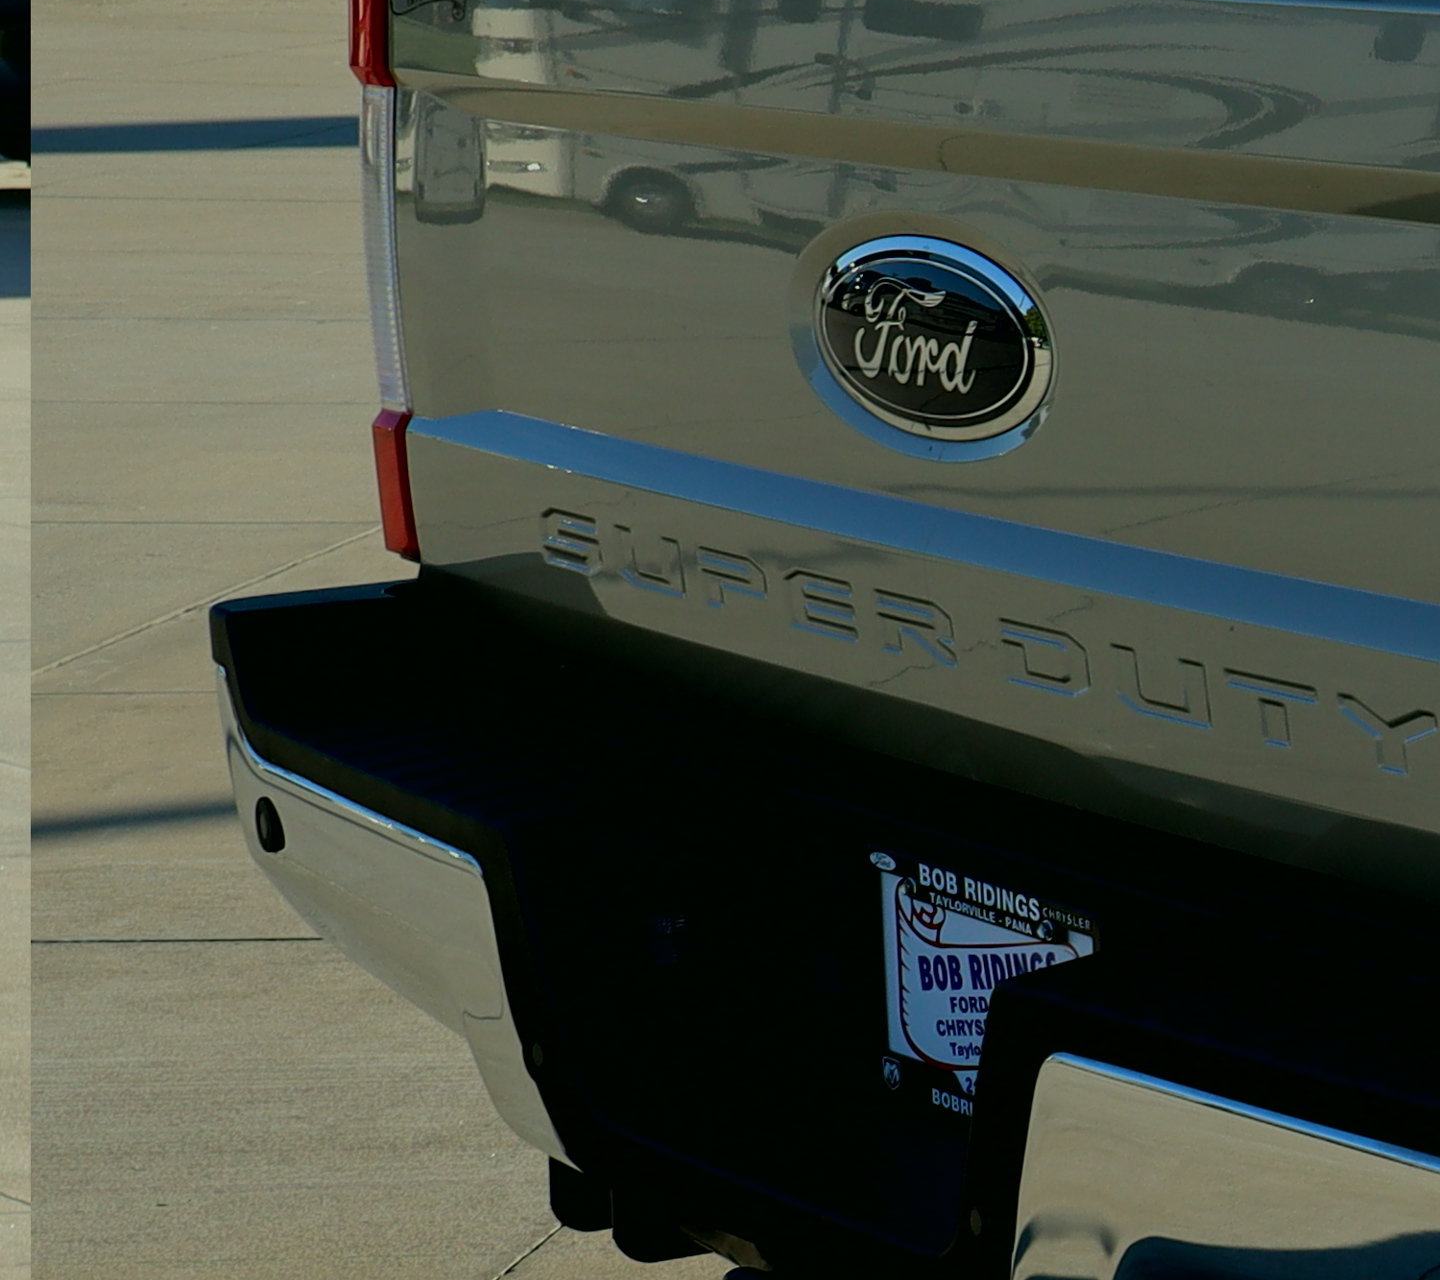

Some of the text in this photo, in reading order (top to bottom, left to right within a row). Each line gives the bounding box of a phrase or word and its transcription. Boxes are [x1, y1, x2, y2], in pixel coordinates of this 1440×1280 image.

[854, 277, 977, 394] Ford
[540, 506, 1438, 776] SUPER DUTY
[918, 863, 1041, 921] BOB RIDINGS
[929, 892, 996, 924] TAYLORVILLE
[1005, 916, 1033, 935] PANA
[1042, 907, 1091, 930] CHRYSLER
[917, 954, 963, 991] BOB
[949, 996, 989, 1013] FORD
